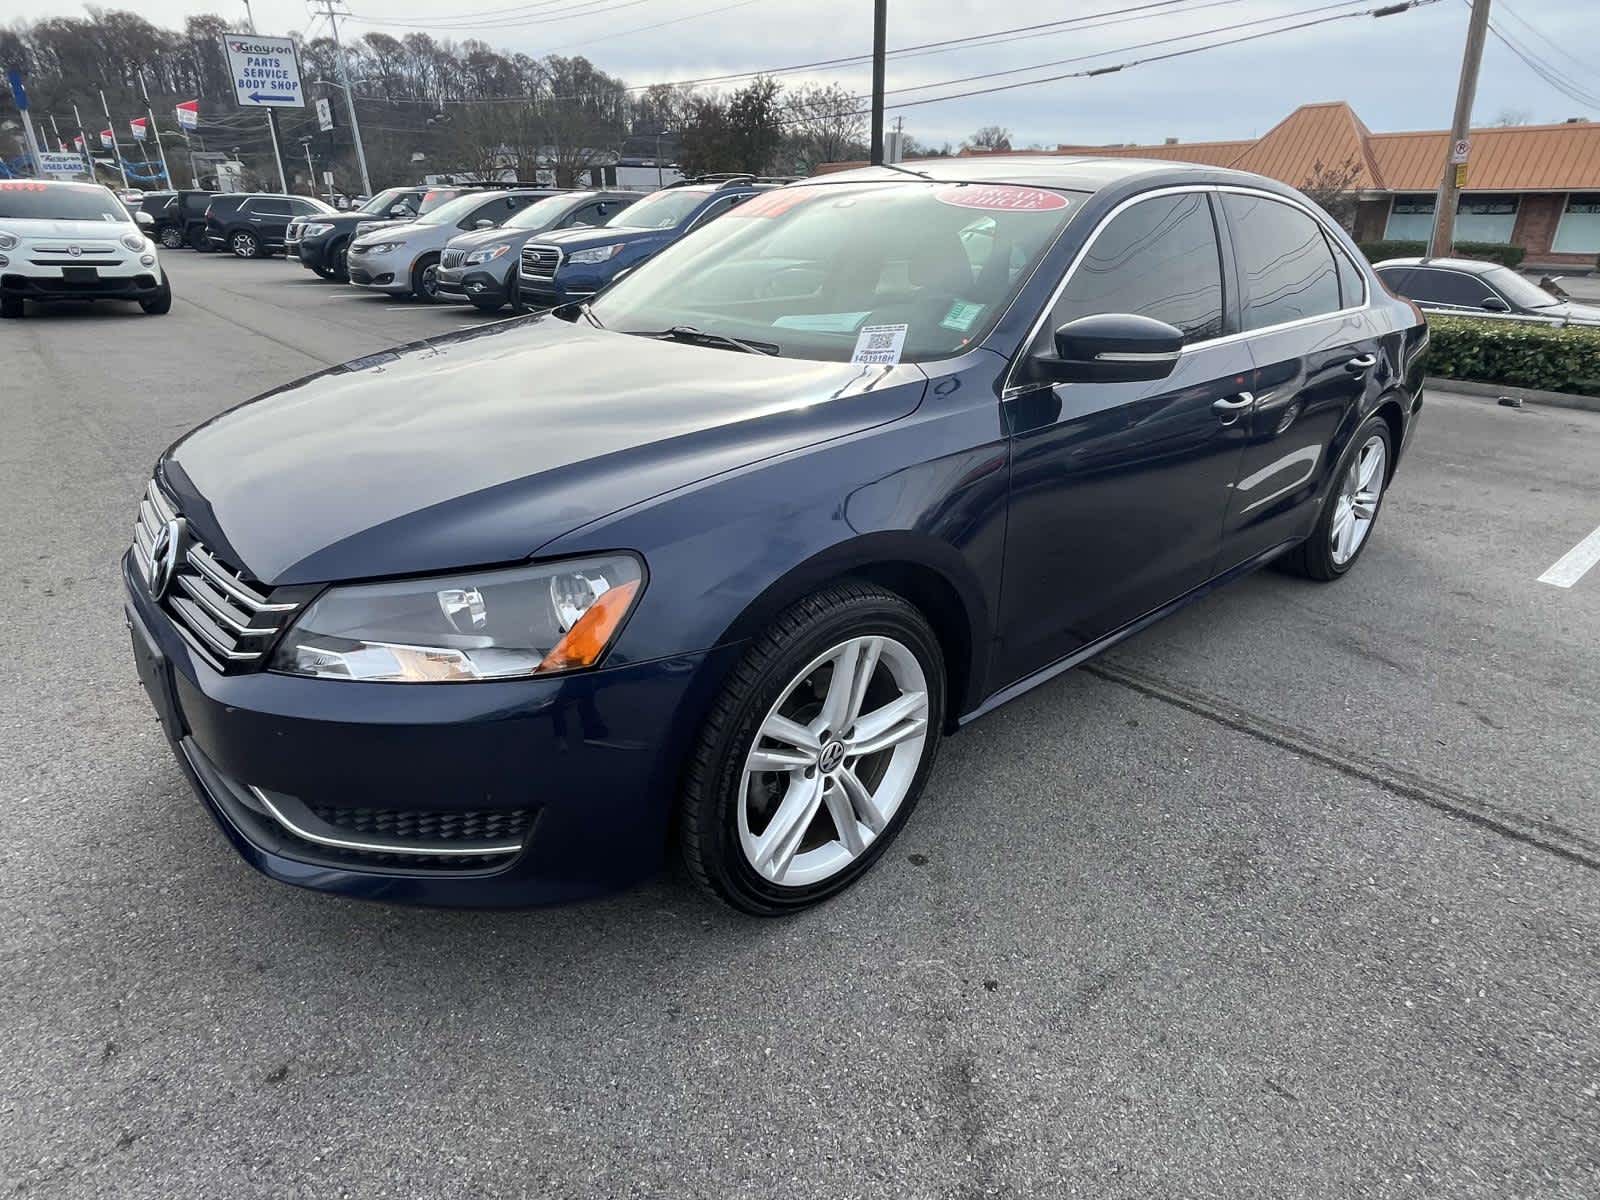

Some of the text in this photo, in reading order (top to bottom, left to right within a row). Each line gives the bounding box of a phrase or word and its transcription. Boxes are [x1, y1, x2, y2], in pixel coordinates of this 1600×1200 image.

[240, 42, 292, 55] Grayson
[247, 57, 281, 68] PARTS
[243, 68, 289, 79] SERVICE
[238, 79, 298, 91] BODY SHOP
